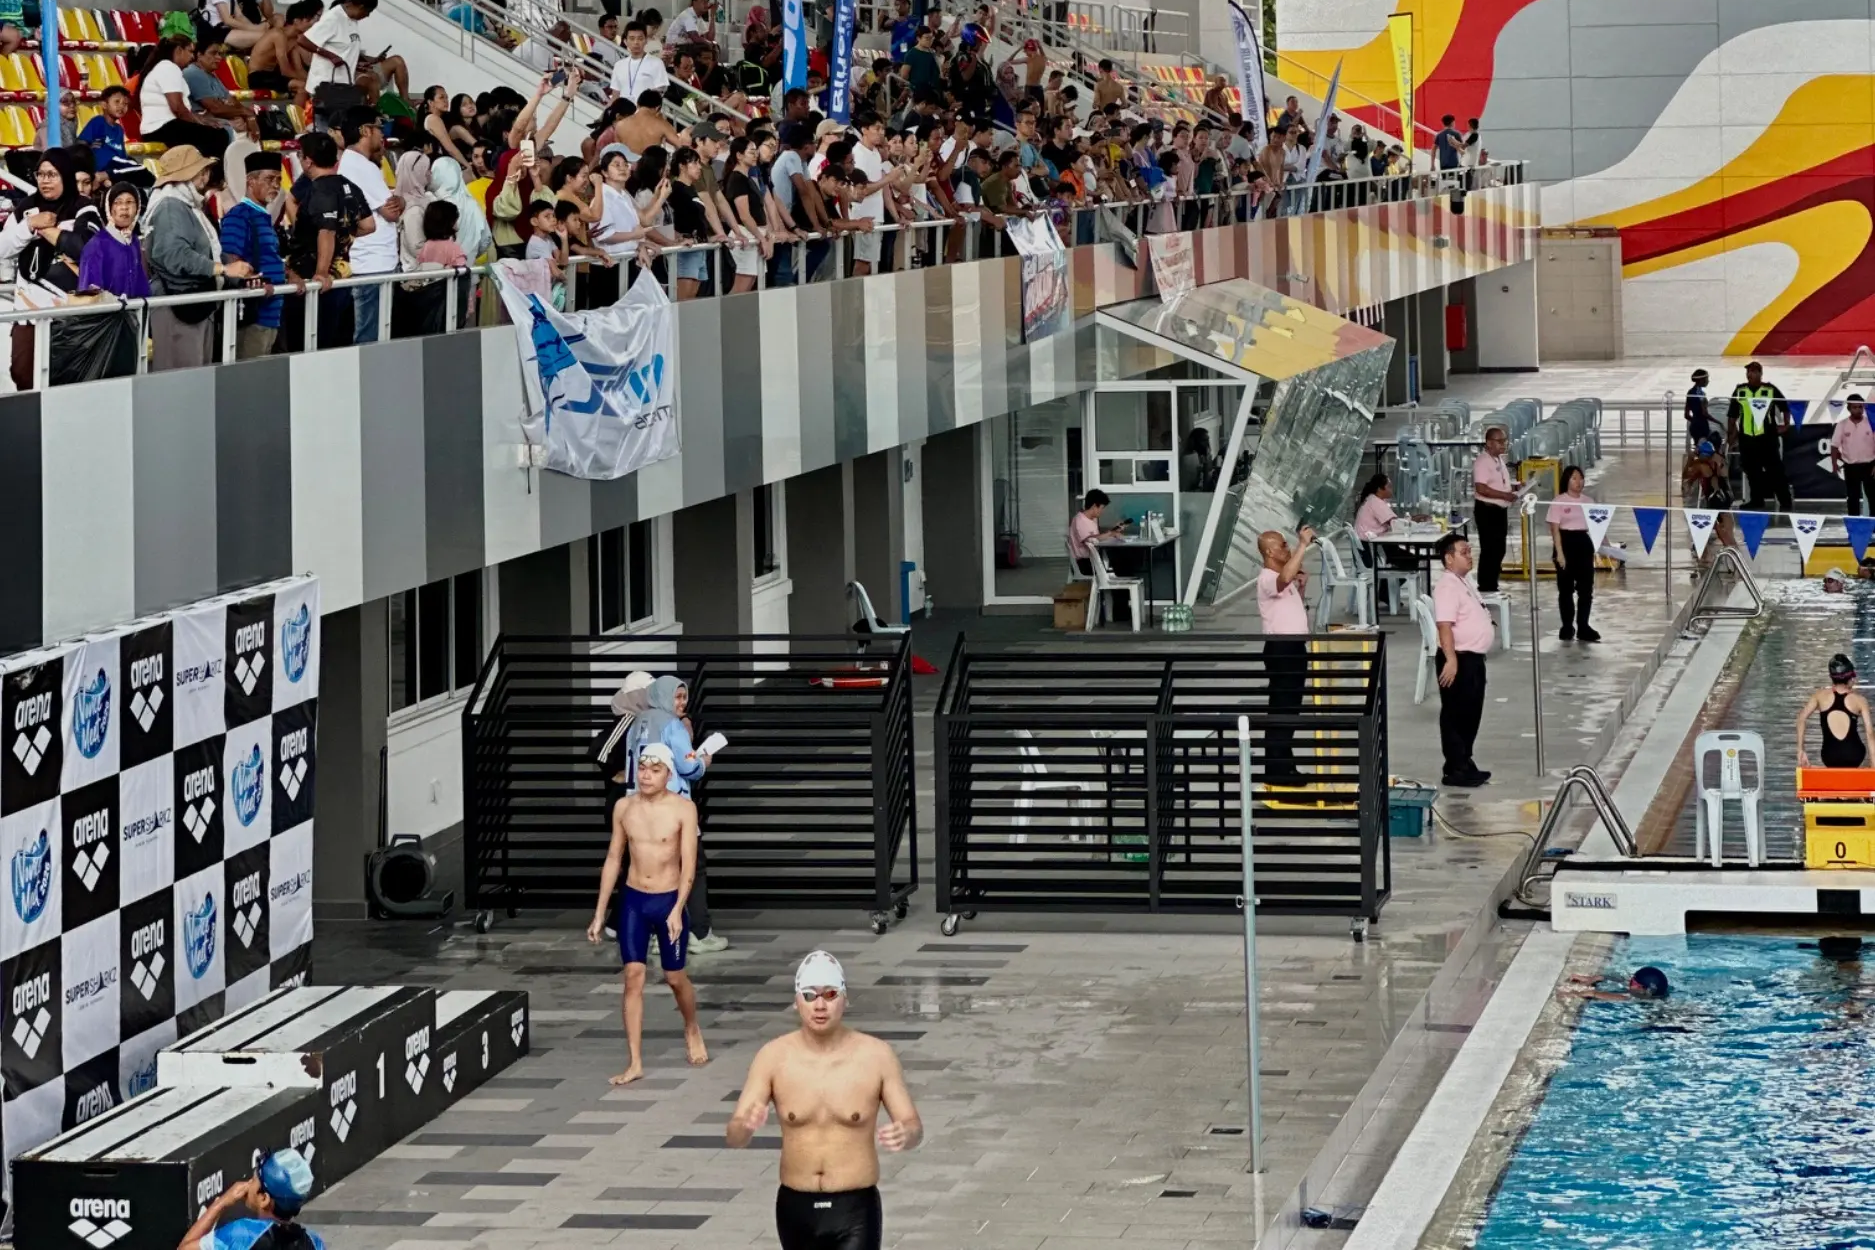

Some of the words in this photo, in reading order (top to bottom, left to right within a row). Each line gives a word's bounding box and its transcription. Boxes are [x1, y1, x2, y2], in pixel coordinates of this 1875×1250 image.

[235, 621, 265, 654] arena
[130, 652, 163, 689] arena
[15, 691, 52, 730] arena
[280, 727, 308, 757] arena
[184, 765, 215, 801] arena
[72, 807, 109, 848] arena
[1835, 841, 1847, 859] 0
[233, 871, 260, 909] arena
[1571, 897, 1612, 908] STARK
[131, 918, 164, 959] arena
[12, 971, 50, 1016] arena
[405, 1025, 430, 1061] arena
[481, 1031, 489, 1069] 3
[376, 1052, 385, 1099] 1
[443, 1051, 457, 1073] arena
[330, 1070, 357, 1108] arena
[290, 1116, 315, 1149] arena
[197, 1170, 223, 1205] arena
[69, 1197, 131, 1219] arena
